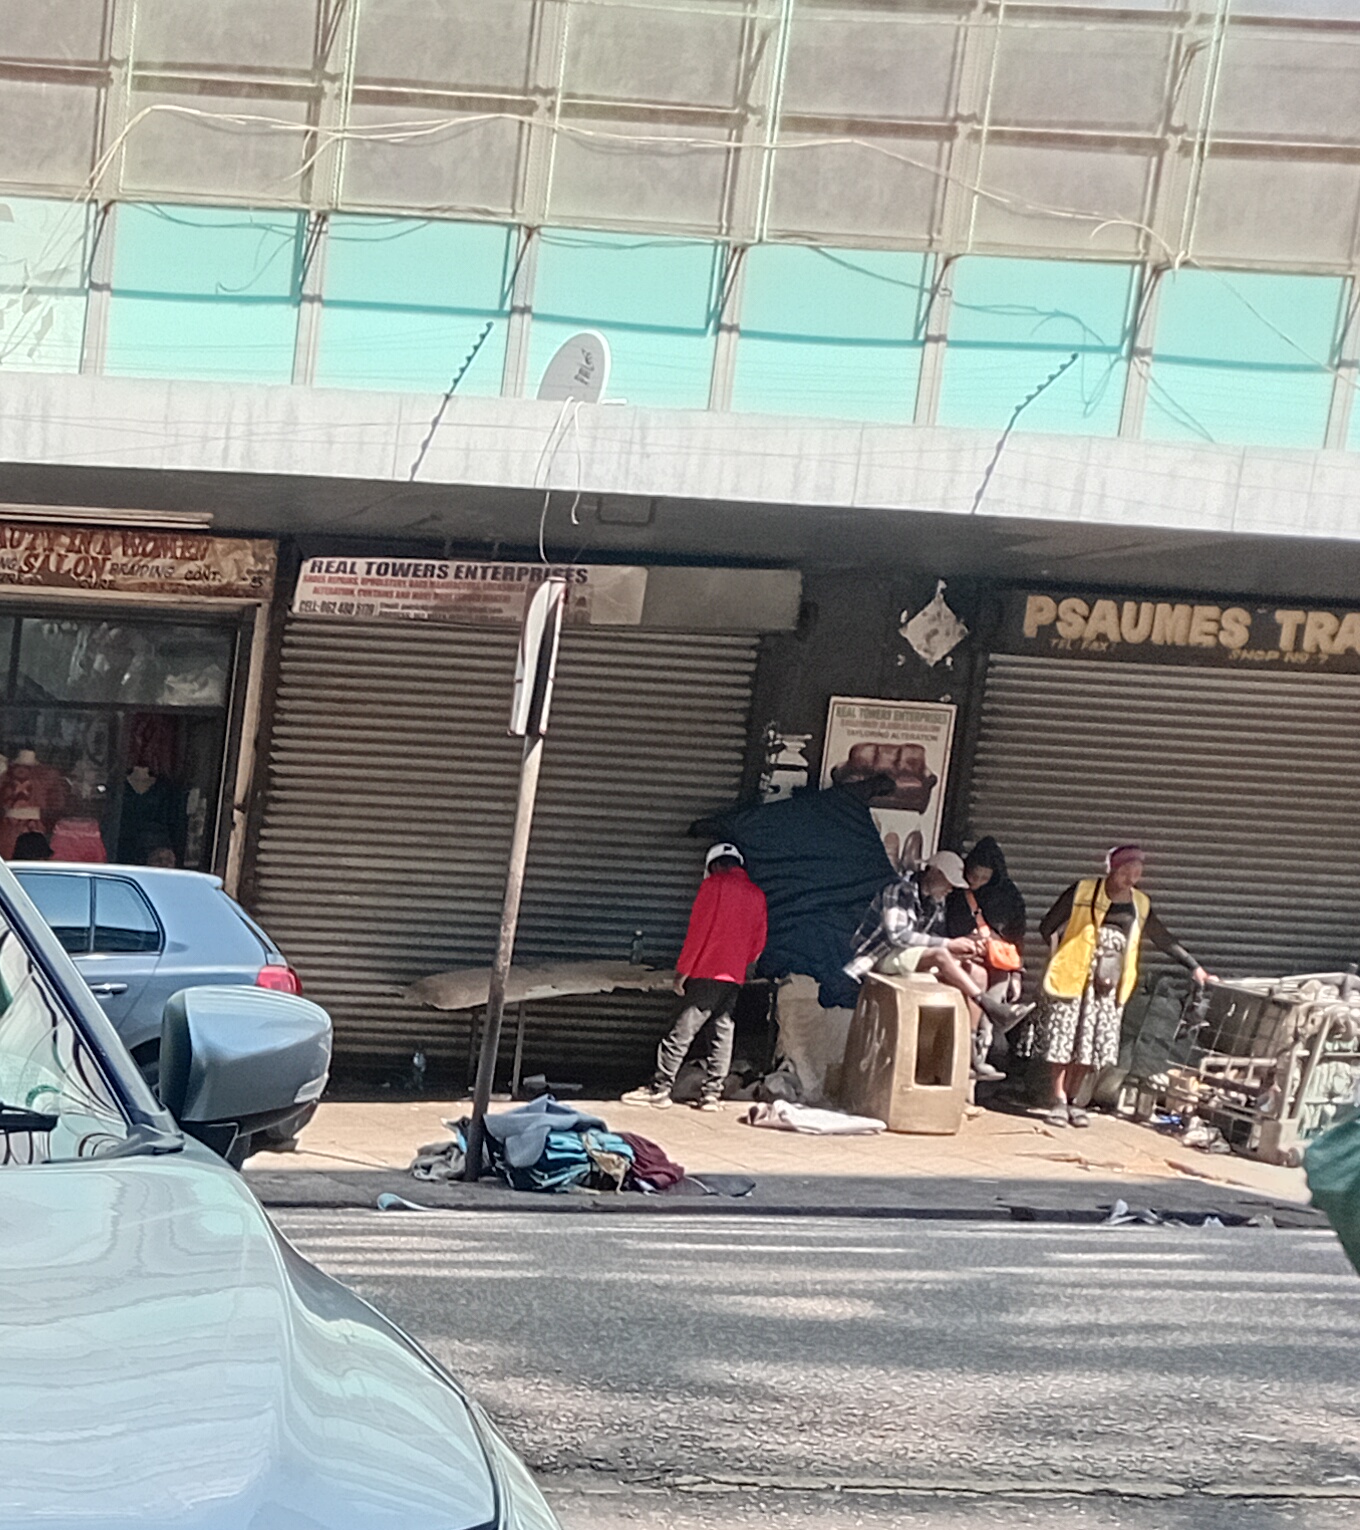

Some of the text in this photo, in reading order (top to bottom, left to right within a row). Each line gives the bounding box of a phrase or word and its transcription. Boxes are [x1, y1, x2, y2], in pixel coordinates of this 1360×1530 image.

[18, 553, 111, 578] SALON
[310, 560, 588, 583] REAL TOWERS ENTERPRISES
[1023, 595, 1252, 649] PSAUMES
